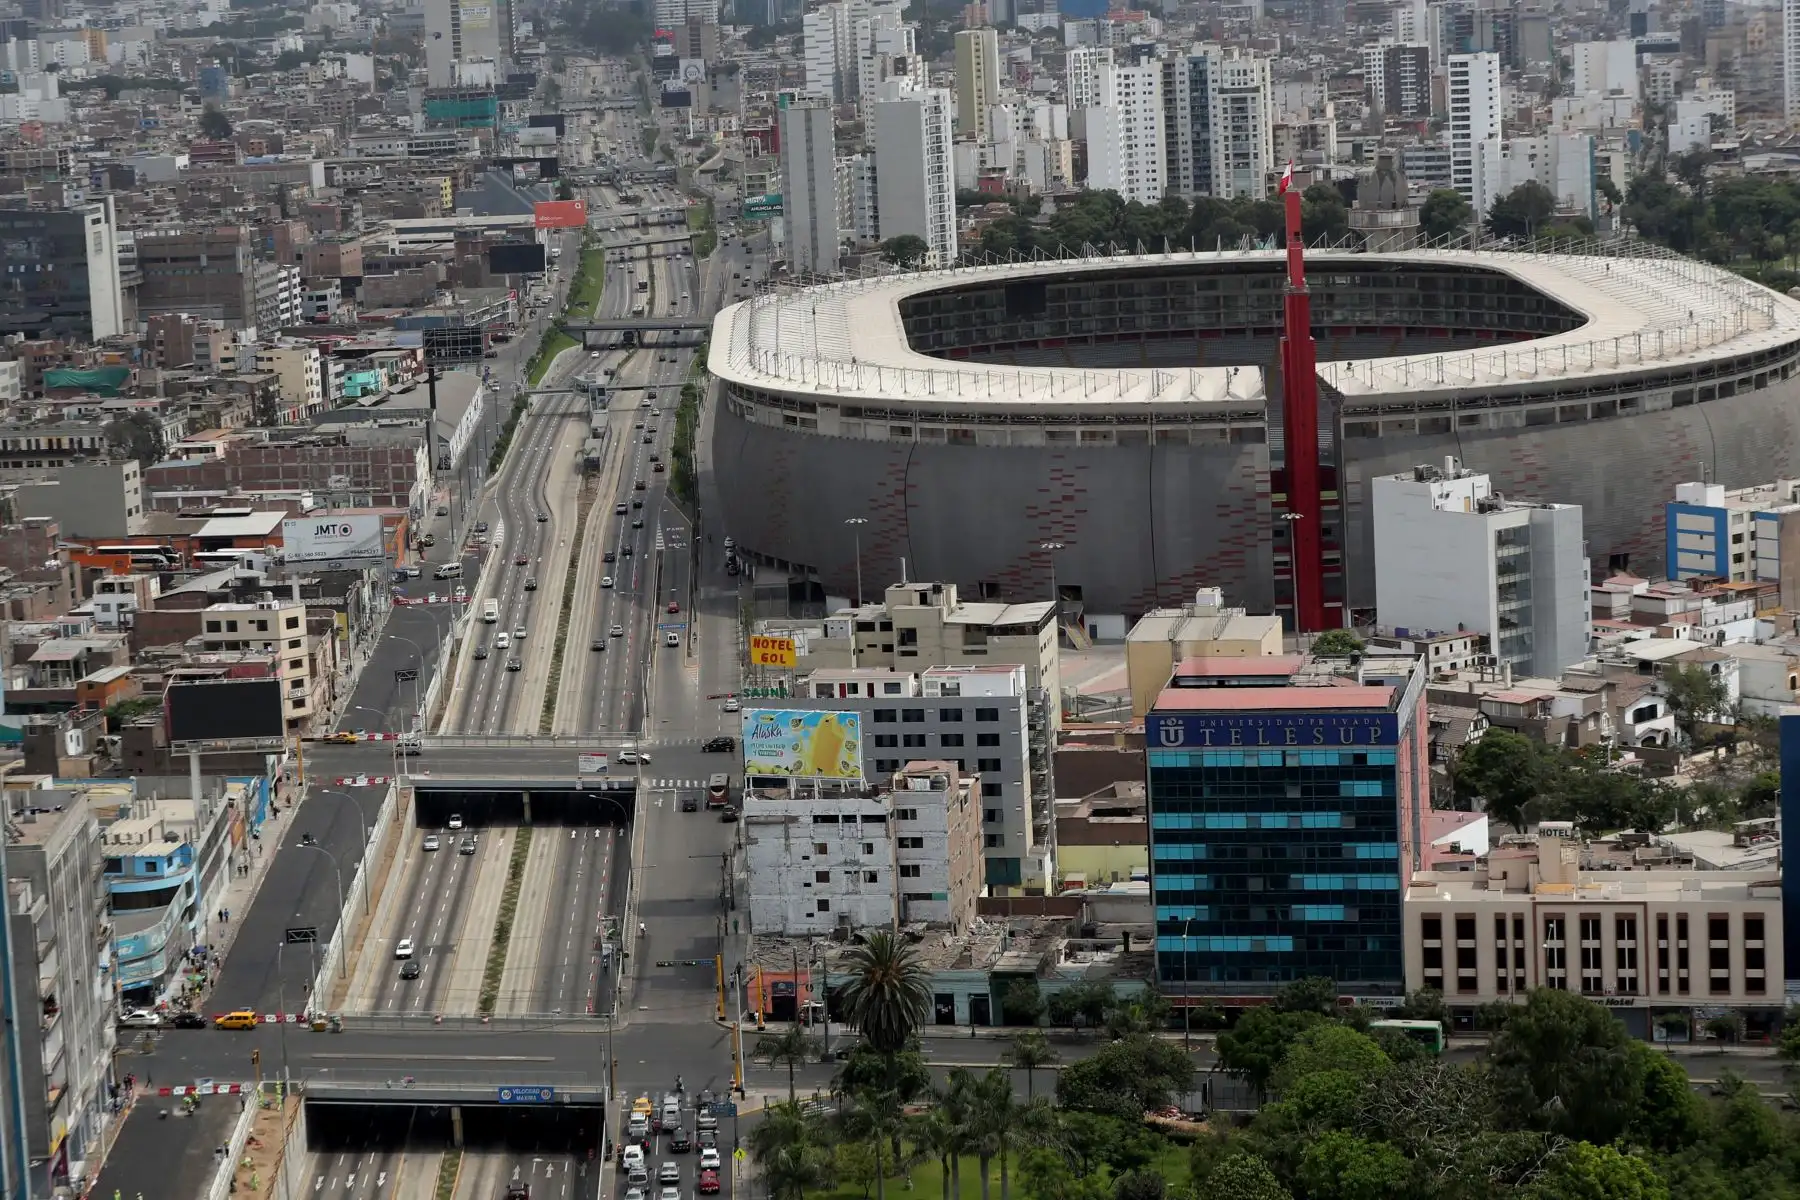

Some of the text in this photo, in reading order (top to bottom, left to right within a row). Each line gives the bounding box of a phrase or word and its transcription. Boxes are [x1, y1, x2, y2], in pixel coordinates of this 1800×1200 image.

[314, 524, 338, 536] JMT
[753, 638, 793, 651] HOTEL
[761, 653, 786, 664] GOL
[1200, 718, 1381, 727] UNIVERSIDAD PRIVADA
[1200, 726, 1382, 746] TELESUP
[1539, 829, 1570, 837] HOTEL
